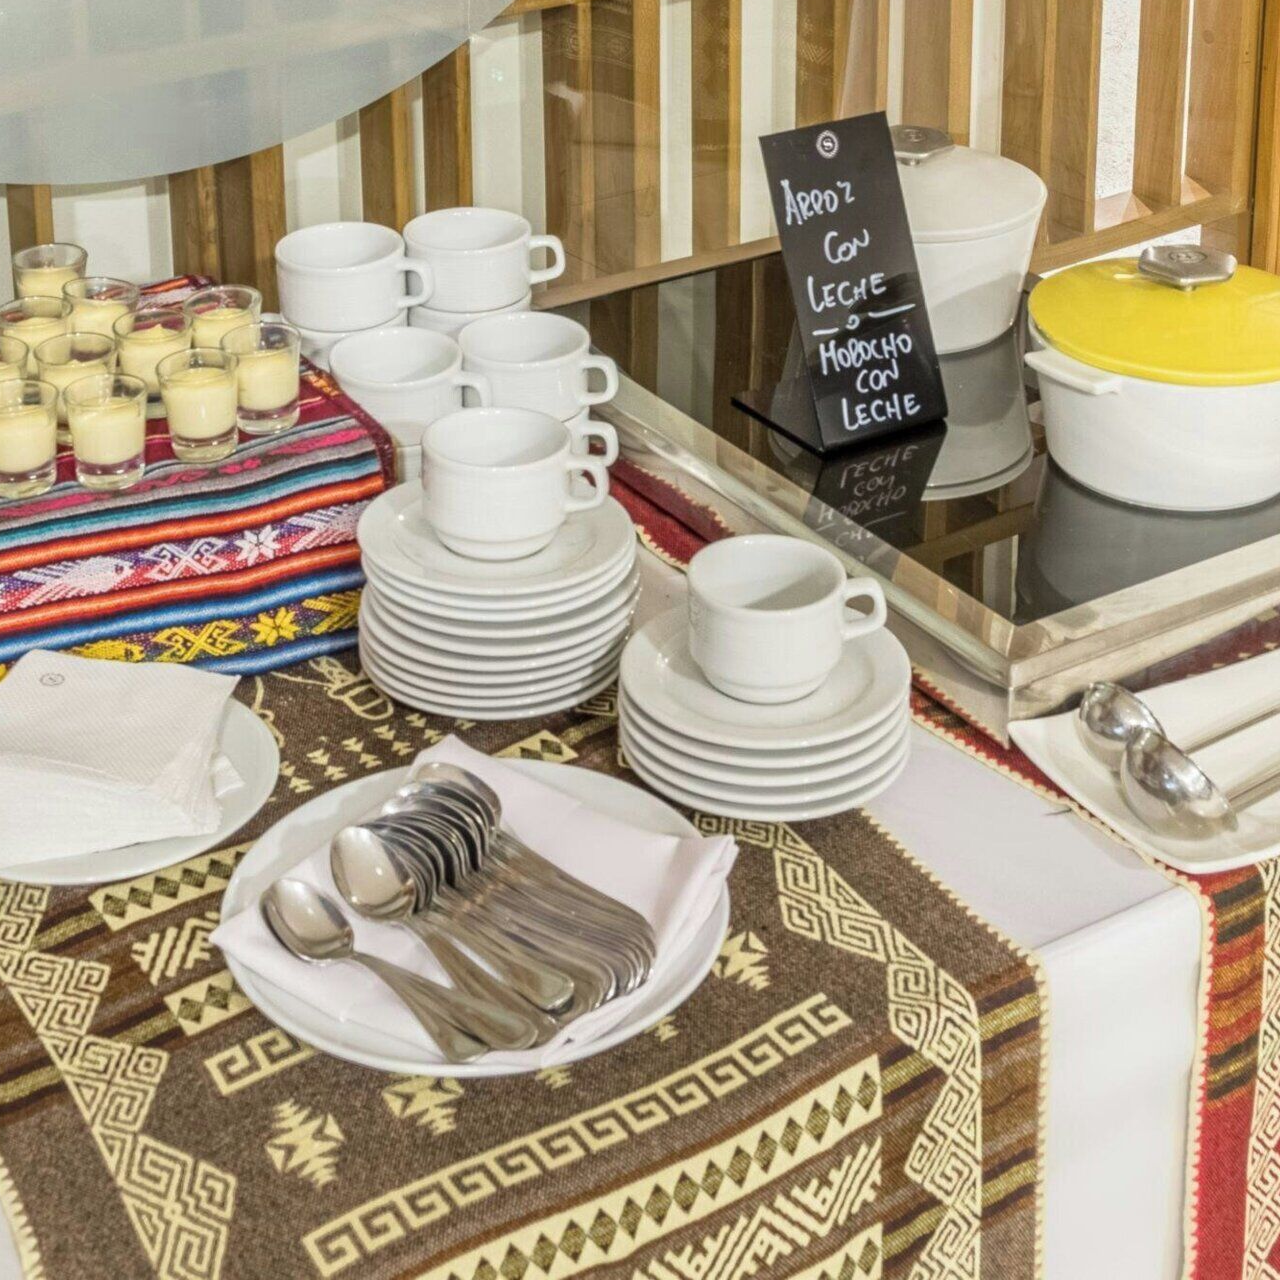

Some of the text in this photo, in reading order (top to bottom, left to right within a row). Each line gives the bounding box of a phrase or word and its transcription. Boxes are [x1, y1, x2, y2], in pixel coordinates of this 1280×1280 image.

[781, 179, 855, 226] ARROZ
[824, 228, 870, 264] CON
[807, 272, 887, 313] LECHE
[819, 332, 913, 376] MOROCHO
[856, 358, 899, 393] CON
[841, 393, 921, 431] LECHE
